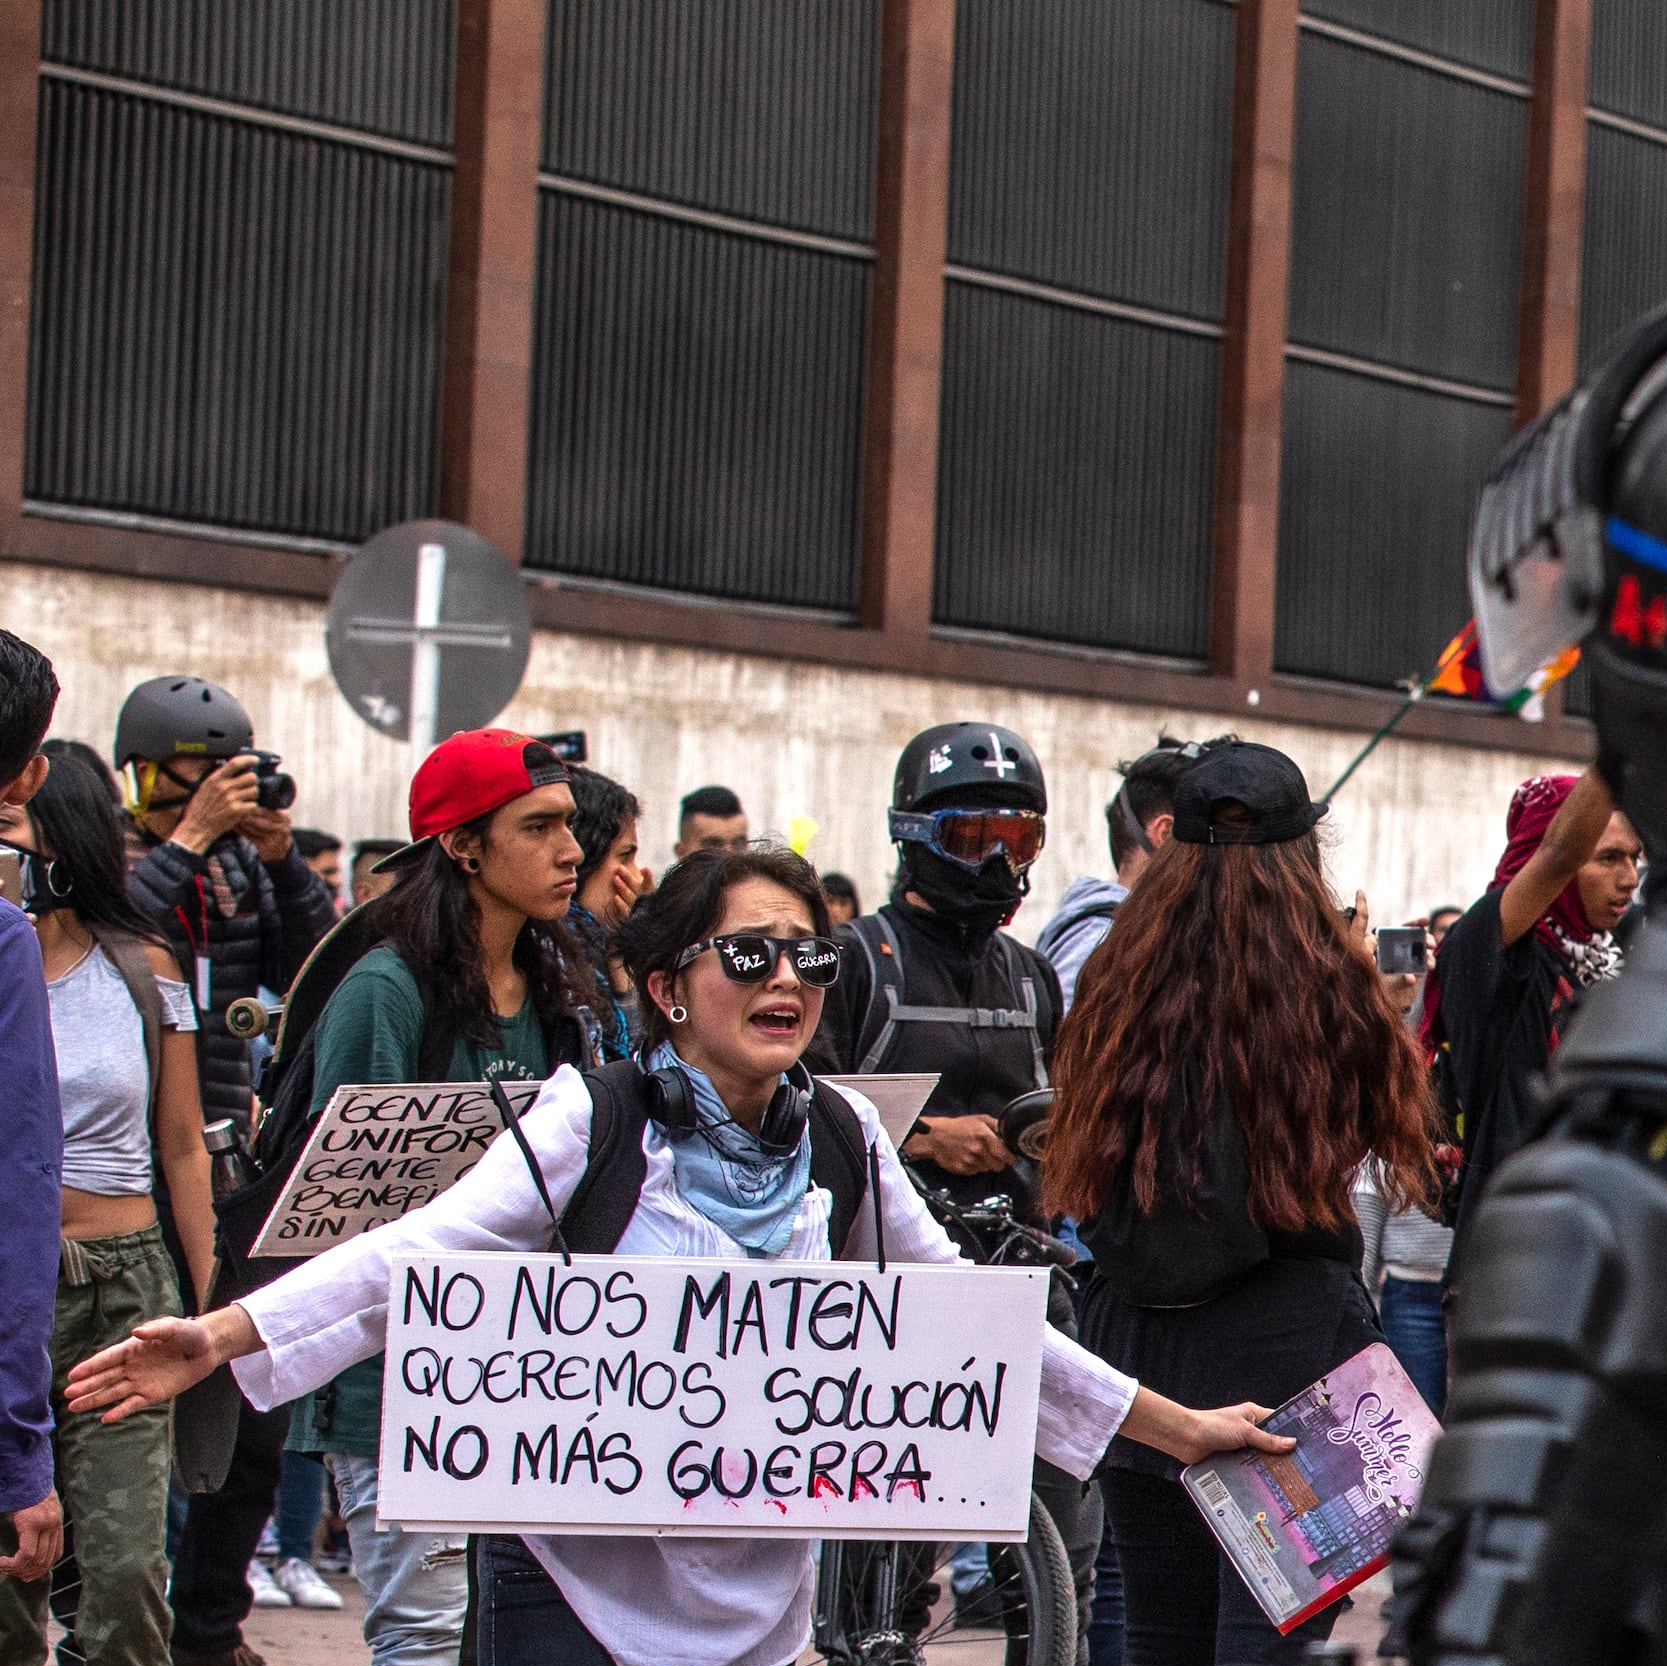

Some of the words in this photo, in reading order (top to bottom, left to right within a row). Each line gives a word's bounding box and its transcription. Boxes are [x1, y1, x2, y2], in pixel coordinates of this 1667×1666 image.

[733, 954, 766, 972] PAZ
[797, 952, 838, 968] GUERRA
[338, 1091, 488, 1125] GENTE
[303, 1157, 441, 1184] GENTE
[403, 1265, 485, 1331] NO
[507, 1265, 648, 1340] NOS
[672, 1270, 902, 1359] MATEN
[401, 1346, 726, 1429] QUEREMOS
[403, 1415, 489, 1481] NO
[511, 1412, 643, 1495] MÁS
